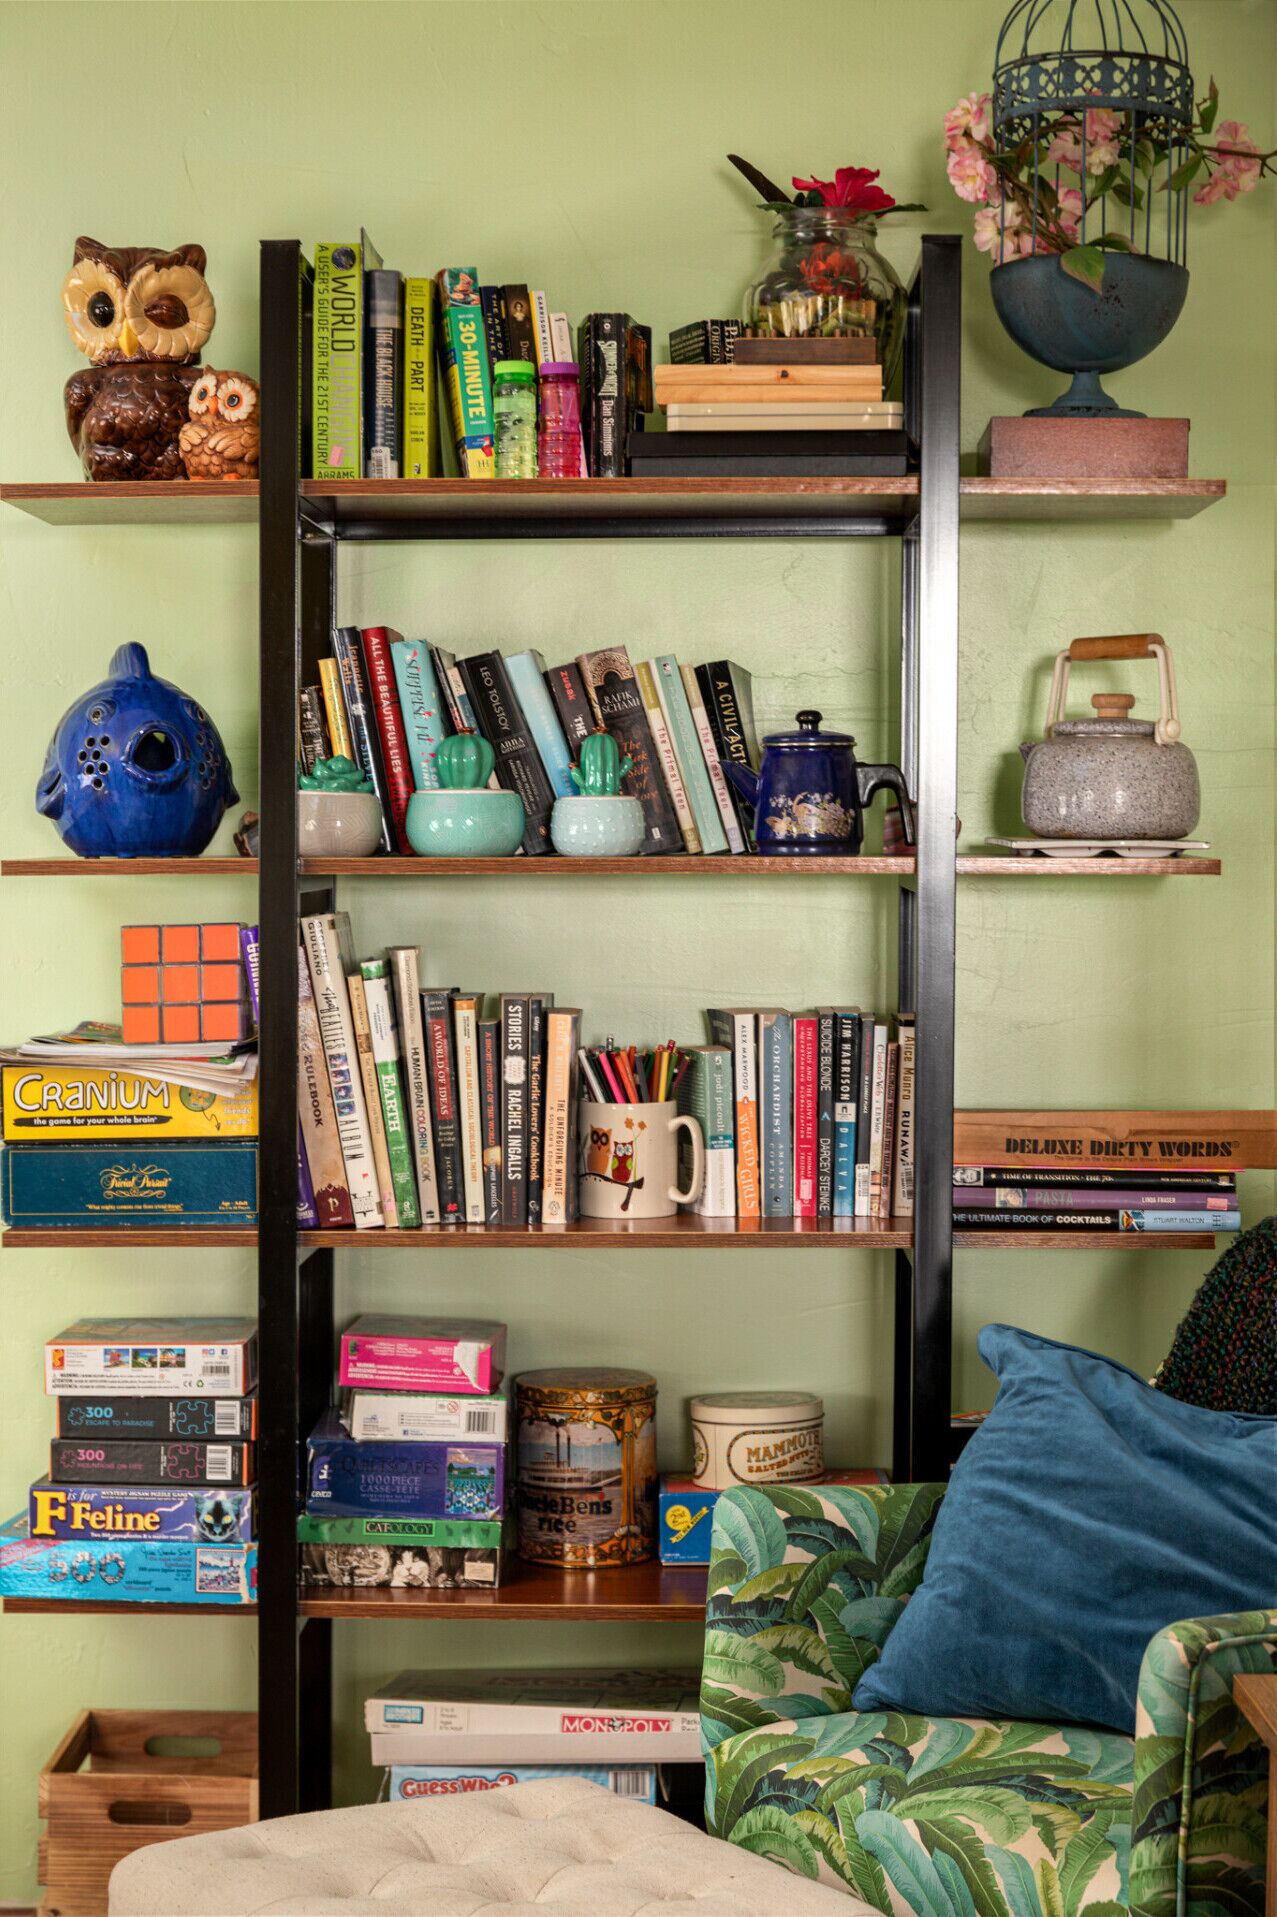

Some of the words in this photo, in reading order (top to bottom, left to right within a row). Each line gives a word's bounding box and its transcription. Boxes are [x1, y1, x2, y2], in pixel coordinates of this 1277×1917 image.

[318, 255, 328, 294] USER'S
[318, 299, 328, 333] GUIDE
[411, 307, 424, 346] DEATH
[318, 336, 328, 358] FOR
[376, 329, 394, 345] THE
[318, 361, 327, 381] THE
[376, 347, 394, 377] BLACK
[411, 361, 424, 392] PART
[458, 321, 486, 418] 30-MINUTE
[318, 385, 327, 412] 21ST
[376, 379, 394, 408] HOUSE
[602, 400, 614, 416] Dan
[318, 416, 328, 465] CENTURY
[602, 417, 615, 456] Simmons
[370, 637, 383, 657] ALL
[374, 659, 387, 682] THE
[716, 681, 729, 690] A
[480, 665, 494, 687] LEO
[488, 688, 511, 731] TOLSTOY
[601, 698, 640, 714] SCHAMI
[604, 690, 633, 703] RAFIK
[378, 685, 397, 746] BEAUTIFUL
[574, 716, 587, 738] THE
[719, 693, 739, 731] CIVIL
[388, 748, 402, 773] LIES
[658, 727, 667, 744] The
[663, 748, 677, 783] Primal
[675, 788, 685, 810] Teen
[700, 726, 709, 744] The
[705, 747, 722, 782] Primal
[717, 786, 729, 809] Teen
[308, 922, 321, 976] GIULIANO
[508, 1005, 522, 1050] STORIES
[820, 1018, 831, 1053] SUICIDE
[842, 1017, 853, 1038] JIM
[410, 1047, 421, 1080] HUMAN
[434, 1031, 444, 1068] WORLD
[531, 1055, 541, 1072] The
[904, 1035, 914, 1062] Alice
[320, 1006, 346, 1050] BEATLES
[339, 1119, 365, 1161] ALBUM
[437, 1071, 446, 1083] OF
[531, 1074, 541, 1100] Garlic
[714, 1073, 724, 1094] jodi
[820, 1056, 831, 1091] BLONDE
[840, 1043, 853, 1101] HARRISON
[903, 1067, 914, 1100] Munro
[304, 1054, 324, 1127] RULEBOOK
[381, 1073, 400, 1133] EARTH
[414, 1081, 424, 1108] BRAIN
[439, 1087, 449, 1115] IDEAS
[487, 1094, 494, 1104] OF
[772, 1044, 780, 1135] ORCHARDIST
[507, 1089, 521, 1131] RACHEL
[531, 1102, 541, 1134] Lovers'
[556, 1099, 565, 1113] THE
[714, 1096, 725, 1131] picoult
[48, 1118, 71, 1126] game
[87, 1118, 105, 1126] your
[416, 1109, 428, 1155] COLORING
[555, 1116, 565, 1165] UNFORGIVING
[738, 1112, 756, 1166] WICKED
[1005, 1138, 1085, 1155] DELUXE
[1089, 1140, 1153, 1156] DIRTY
[1157, 1141, 1233, 1157] WORDS
[421, 1156, 431, 1181] BOOK
[508, 1134, 522, 1180] INGALLS
[530, 1136, 541, 1180] Cookbook
[819, 1137, 830, 1172] DARCEY
[100, 1173, 135, 1190] Trivial
[135, 1174, 170, 1188] Pursuit
[554, 1168, 563, 1195] MINUTE
[739, 1168, 757, 1209] GIRLS
[819, 1175, 830, 1210] STEINKE
[1035, 1192, 1074, 1205] PASTA
[968, 1214, 1010, 1223] ULTIMATE
[1012, 1215, 1038, 1223] BOOK
[1040, 1215, 1054, 1223] OF
[1056, 1215, 1111, 1224] COCKTAILS
[86, 1407, 113, 1418] 300
[77, 1450, 105, 1461] 300
[747, 1458, 788, 1473] SALTED
[360, 1474, 391, 1485] 1000
[67, 1489, 77, 1501] is
[79, 1489, 97, 1503] for
[32, 1490, 68, 1536] F
[70, 1502, 160, 1531] Feline
[538, 1517, 577, 1533] rice
[48, 1551, 126, 1585] 500
